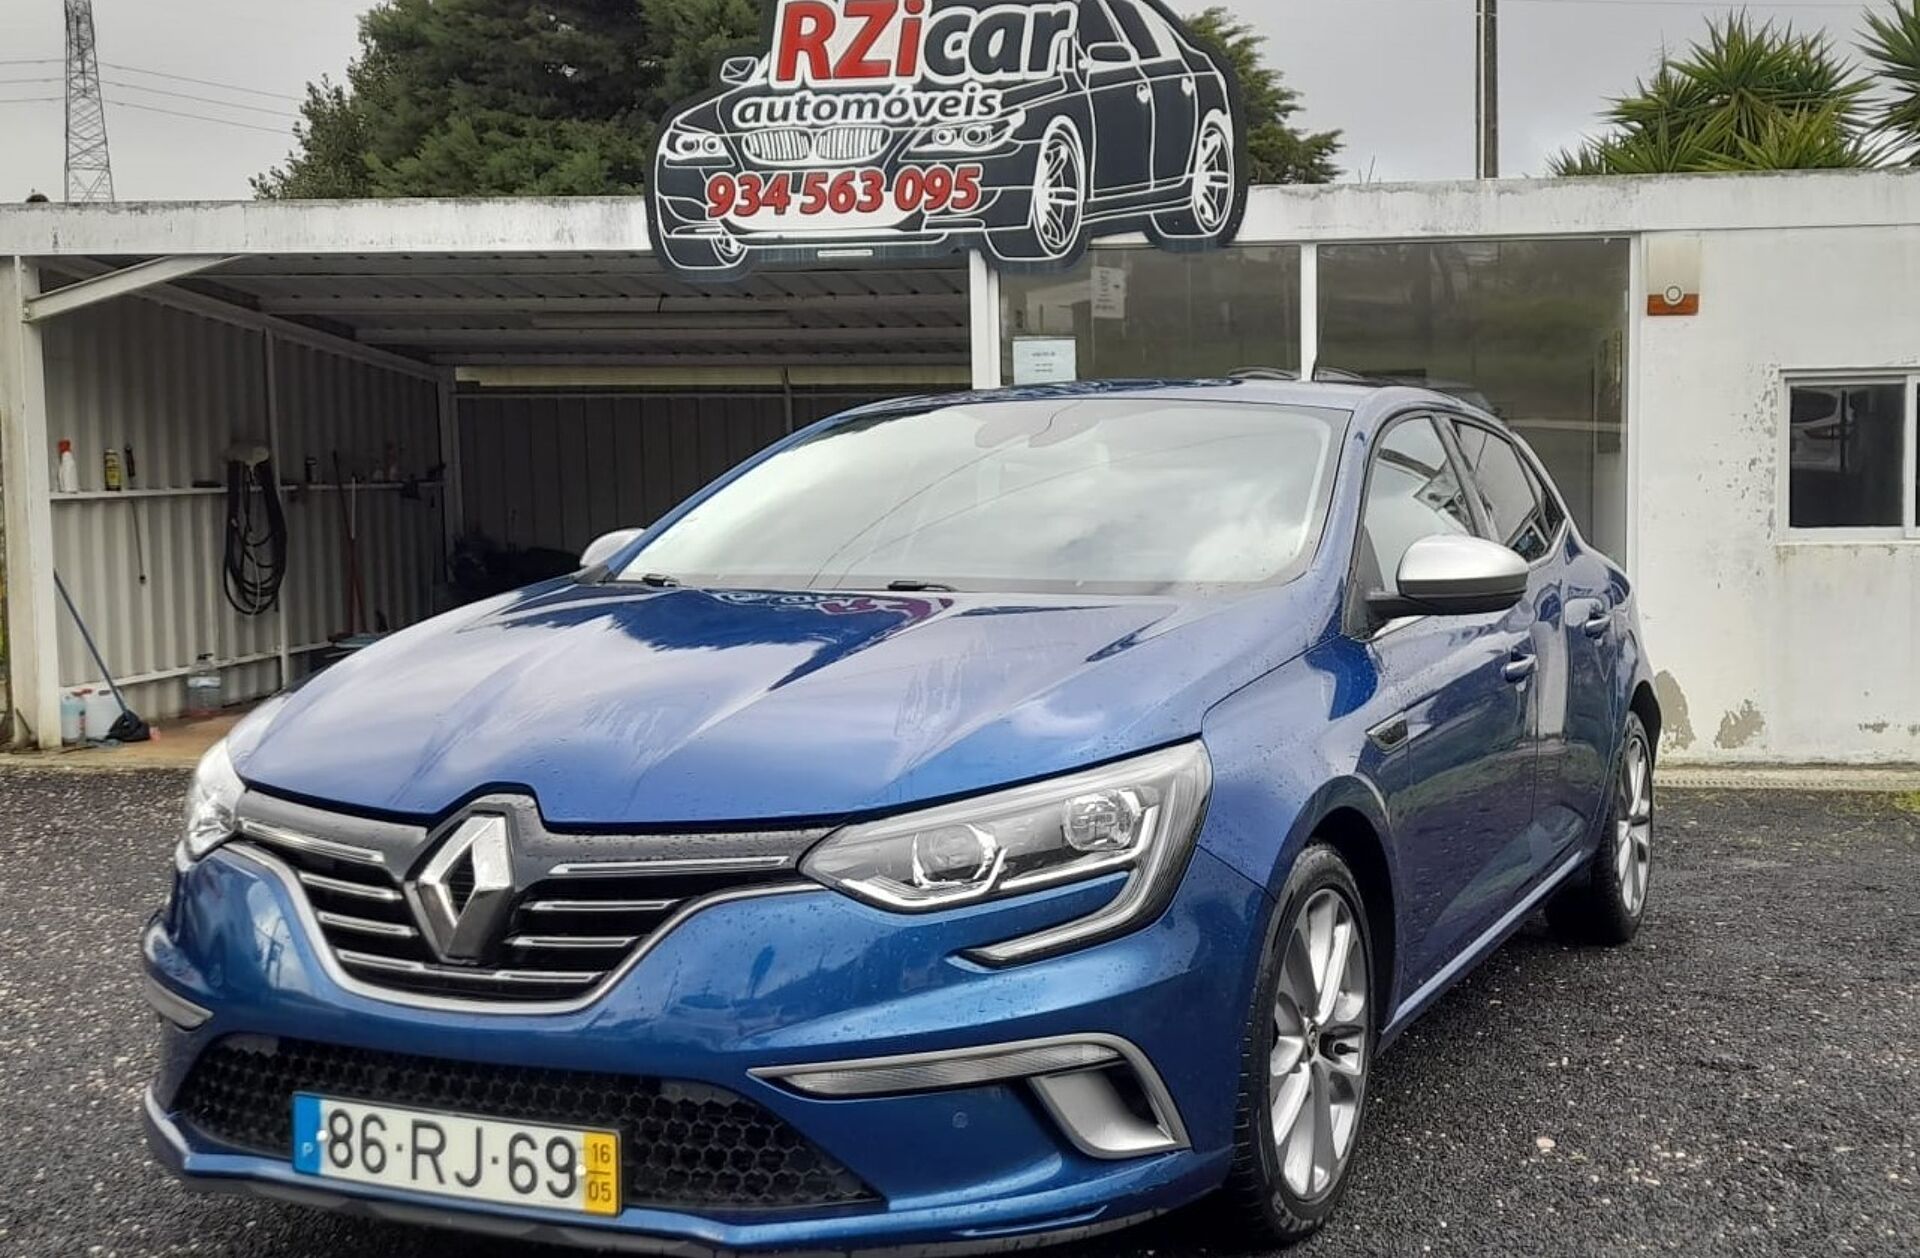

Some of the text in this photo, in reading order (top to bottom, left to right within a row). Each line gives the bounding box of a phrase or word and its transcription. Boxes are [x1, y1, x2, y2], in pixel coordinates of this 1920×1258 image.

[775, 0, 1072, 81] RZicar
[736, 85, 997, 124] automóveis
[707, 165, 981, 218] 934 563 095
[592, 1143, 612, 1165] 16
[588, 1181, 612, 1203] 05
